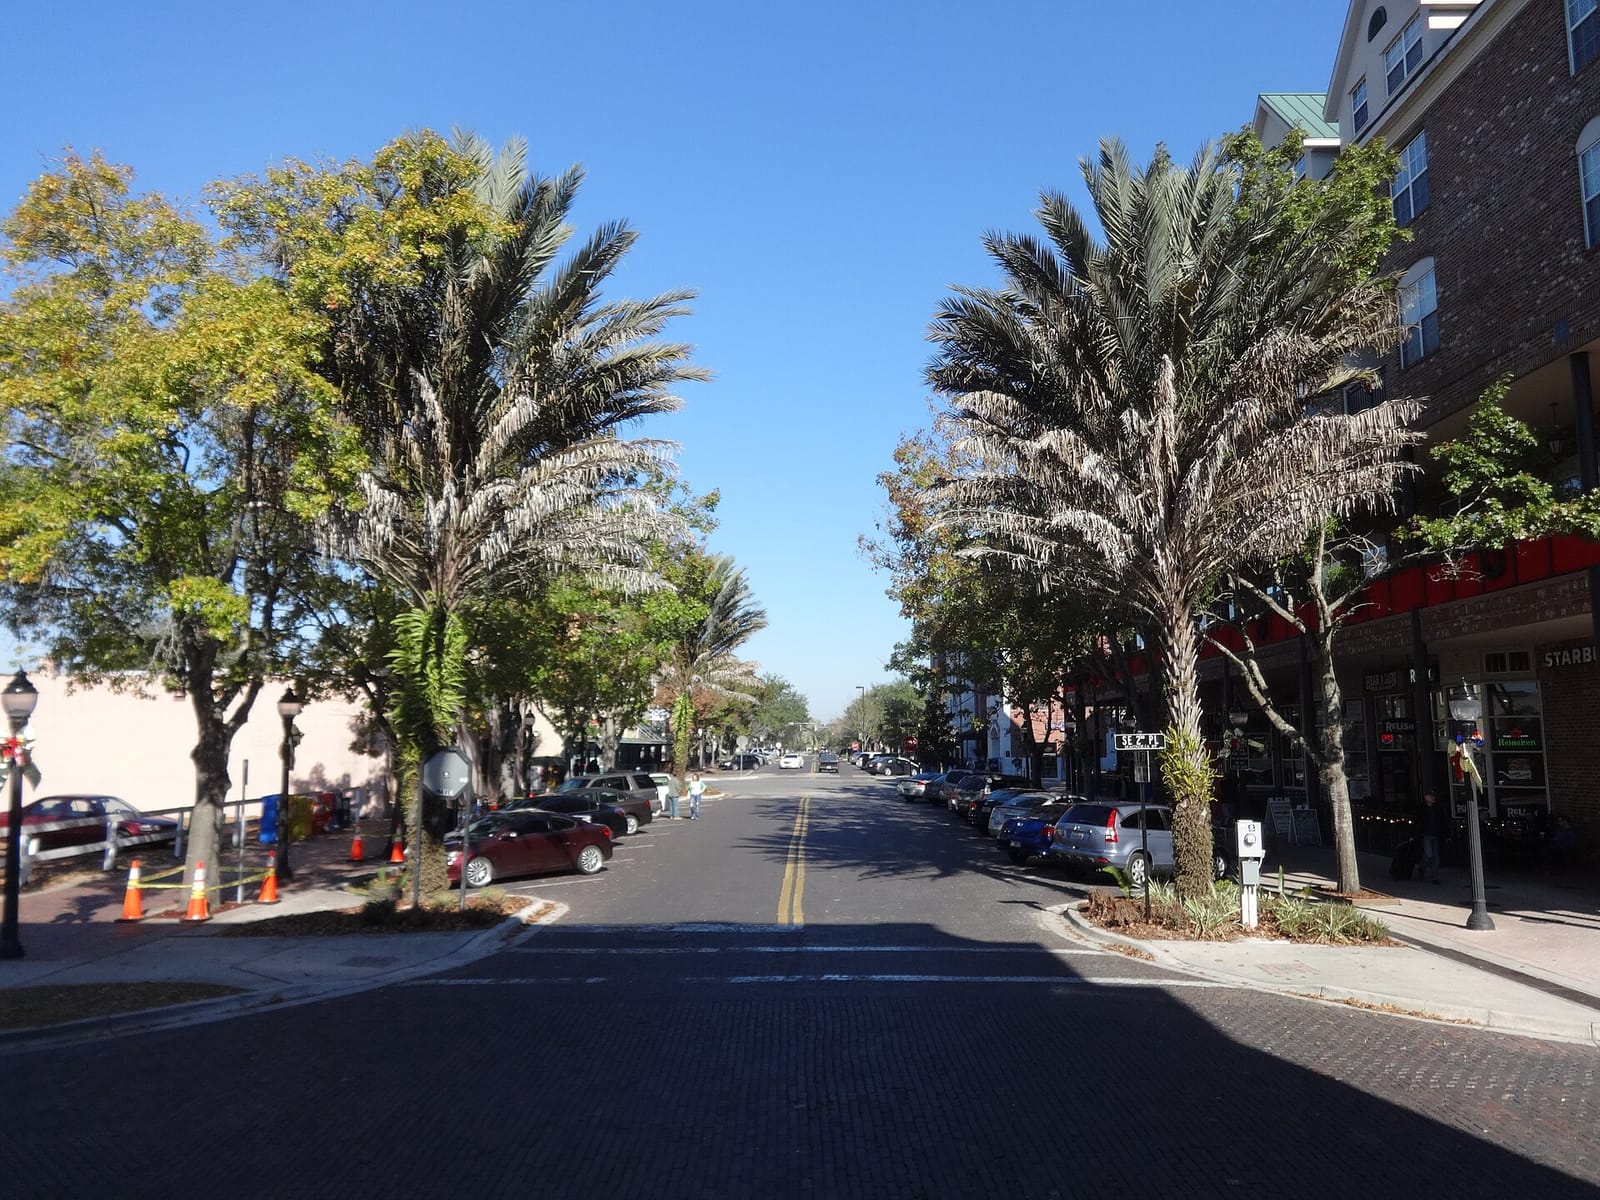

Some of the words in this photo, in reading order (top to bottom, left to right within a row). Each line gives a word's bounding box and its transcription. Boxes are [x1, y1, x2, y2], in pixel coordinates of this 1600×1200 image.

[1121, 735, 1133, 746] SE
[1148, 734, 1159, 746] PL
[1497, 738, 1537, 747] Heineken
